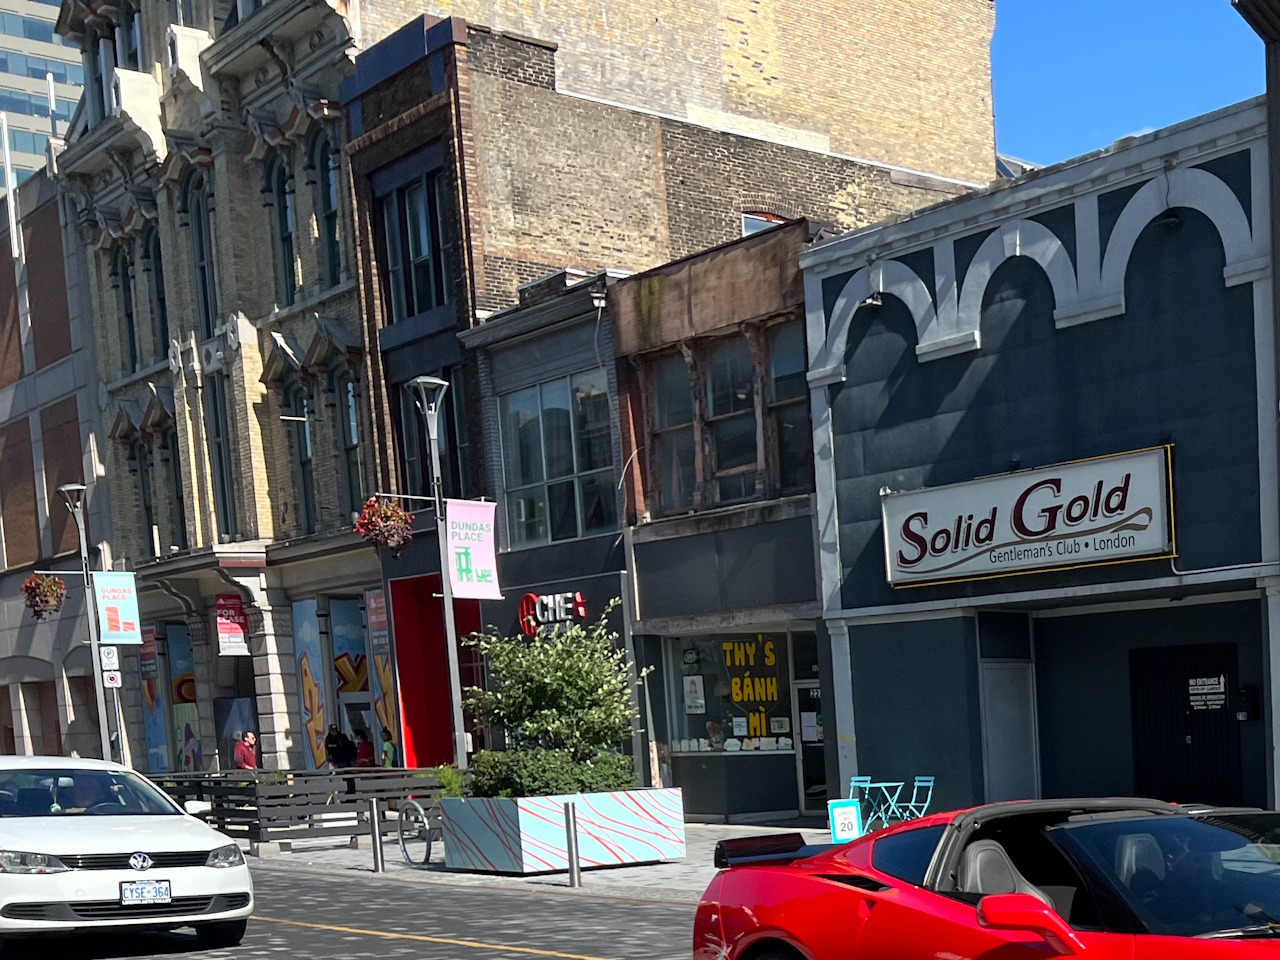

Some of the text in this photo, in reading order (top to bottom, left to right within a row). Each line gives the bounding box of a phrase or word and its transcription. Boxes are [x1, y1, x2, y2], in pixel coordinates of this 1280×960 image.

[451, 520, 492, 533] DUNDAS
[896, 472, 1132, 568] Solid Gold
[451, 531, 483, 542] PLACE
[989, 533, 1136, 563] Gentleman's Club London
[102, 593, 127, 601] PLACE
[217, 609, 235, 617] FOR
[217, 615, 245, 623] LEASE
[722, 633, 776, 667] THY'S
[731, 670, 778, 703] BÁNH
[748, 705, 768, 737] MÌ
[840, 821, 854, 832] 20
